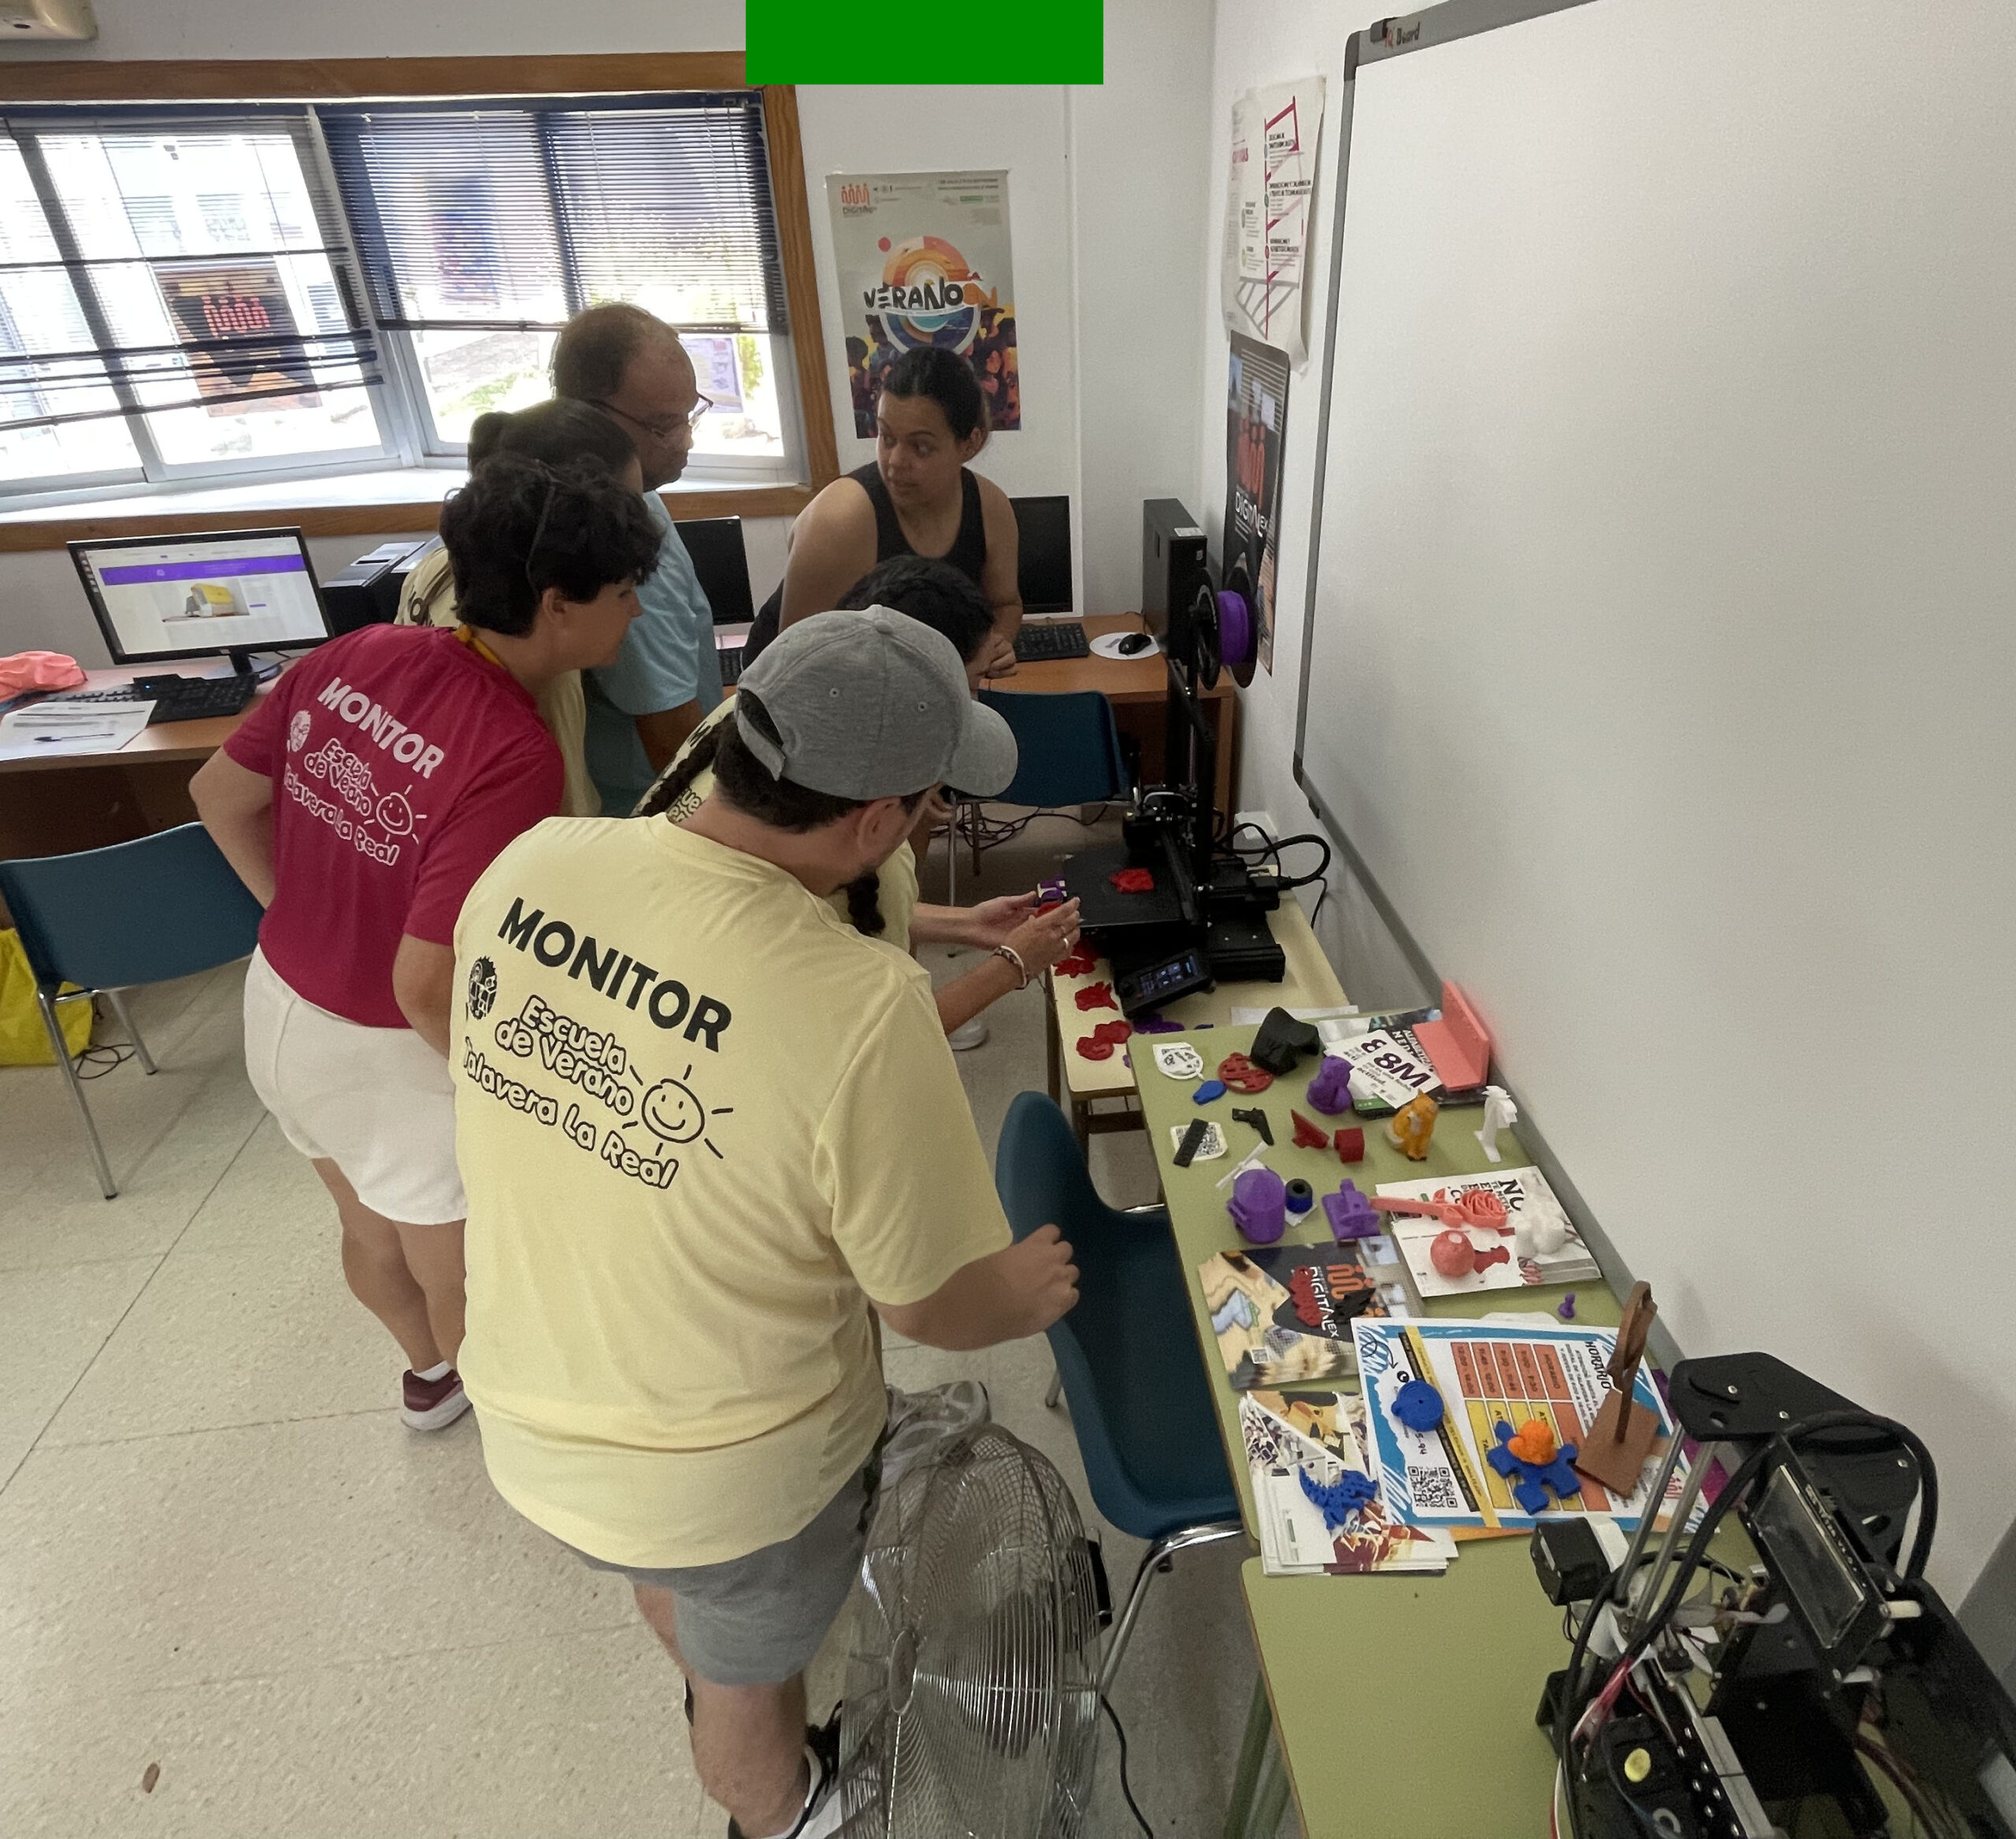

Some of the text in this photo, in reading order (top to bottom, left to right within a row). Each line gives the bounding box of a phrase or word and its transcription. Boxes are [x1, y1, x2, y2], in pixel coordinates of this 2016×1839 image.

[1396, 21, 1420, 46] Board
[863, 276, 963, 310] VERANO
[317, 677, 444, 779] MONITOR
[304, 752, 372, 816] de Veano
[354, 825, 399, 866] Real
[498, 896, 732, 1052] MONITOR
[520, 995, 626, 1075] Escuela
[495, 1018, 634, 1116] de Verano
[1373, 1053, 1431, 1088] 8M
[563, 1104, 596, 1151] La
[601, 1130, 679, 1188] Real
[1498, 1179, 1525, 1211] NO
[1544, 1355, 1560, 1389] HORARIO
[1584, 1341, 1612, 1389] HORARIO
